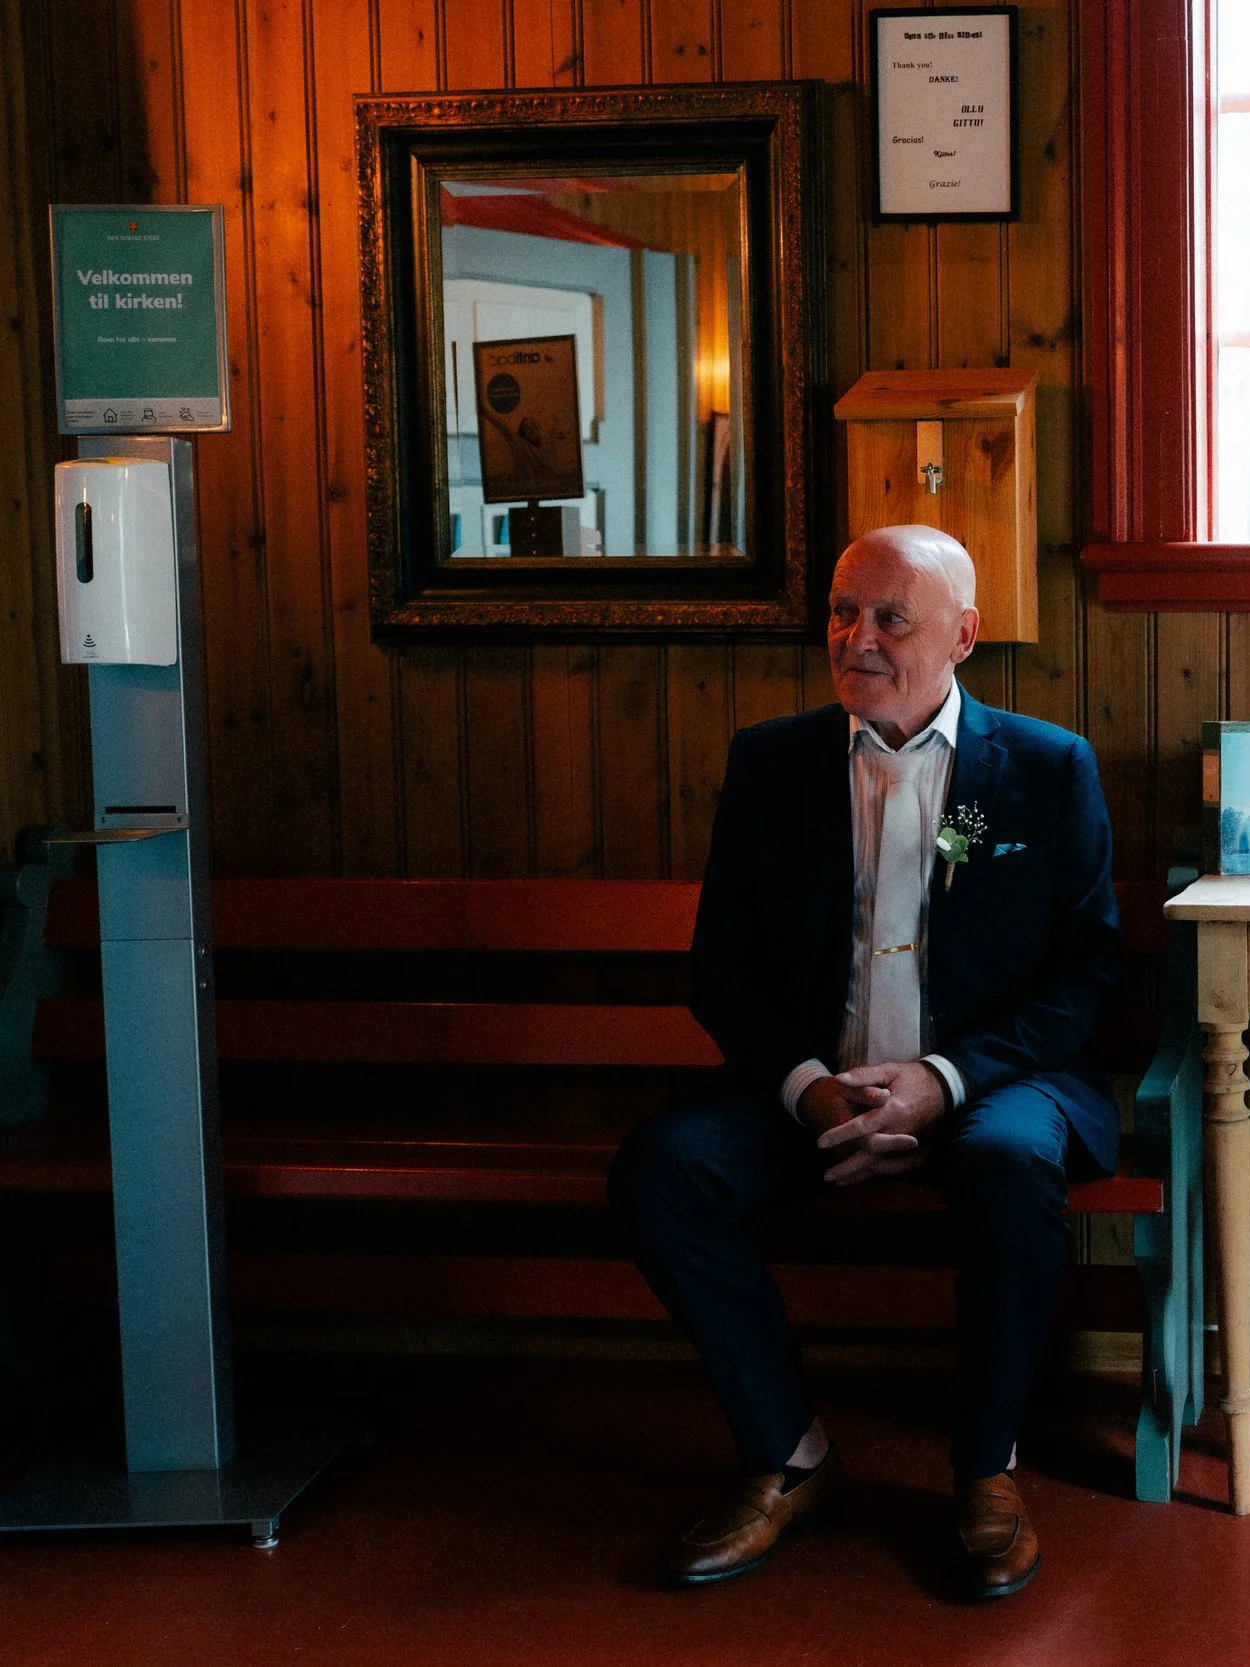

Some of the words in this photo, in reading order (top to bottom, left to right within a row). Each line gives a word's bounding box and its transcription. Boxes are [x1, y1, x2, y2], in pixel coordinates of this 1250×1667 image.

[892, 61, 915, 69] Thank
[917, 61, 933, 70] you!
[961, 105, 984, 114] OLLU
[892, 136, 924, 144] Gracias!
[929, 179, 961, 189] Grazie!
[76, 269, 193, 286] Velkommen
[88, 293, 109, 310] til
[115, 293, 184, 310] kirken!
